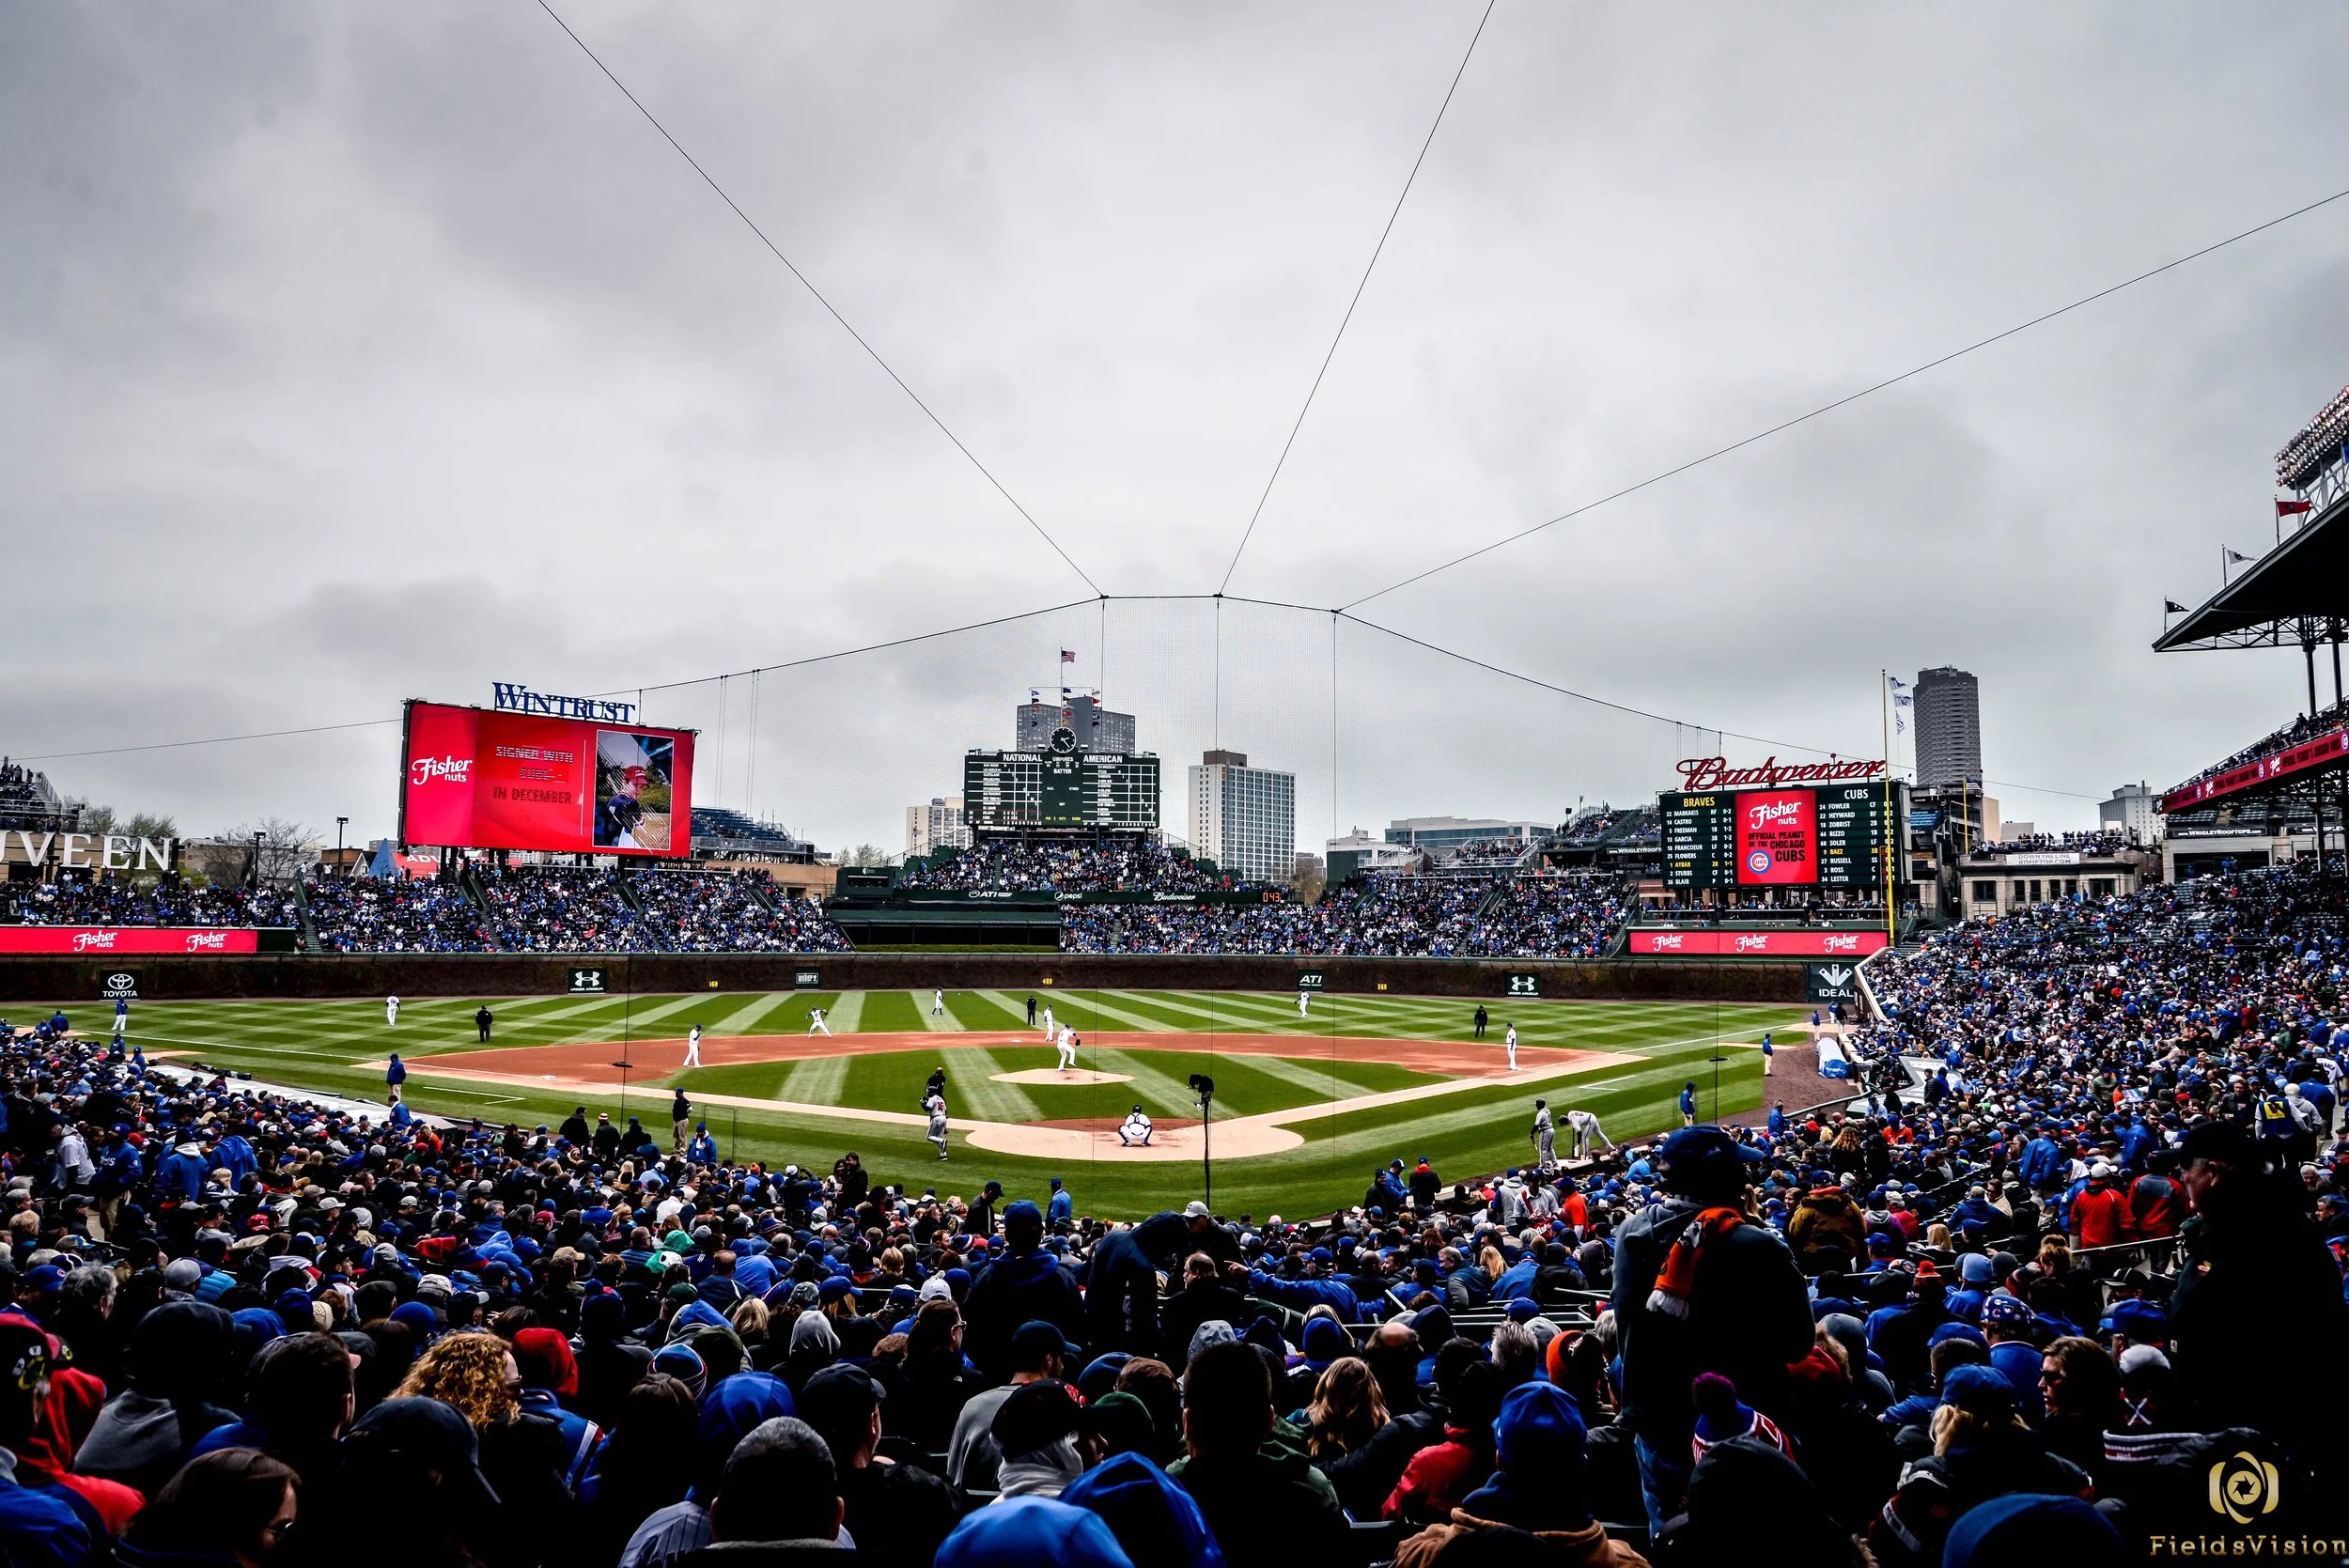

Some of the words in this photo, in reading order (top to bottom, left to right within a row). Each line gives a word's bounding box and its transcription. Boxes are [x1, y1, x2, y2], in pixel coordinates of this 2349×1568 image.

[491, 682, 635, 722] WINTRUST
[412, 755, 473, 785] Fisher
[444, 772, 467, 782] nuts
[1676, 753, 1886, 791] Budweiser
[493, 787, 507, 800] IN
[512, 788, 571, 804] DECEMBER
[1683, 797, 1715, 807] BRAVES
[1844, 789, 1868, 799] CUBS
[1750, 800, 1801, 829] Fisher
[1770, 840, 1805, 849] CHICAGO
[1775, 850, 1805, 862] CUBS
[1152, 892, 1196, 901] Budweiser
[73, 930, 117, 951] Fisher
[187, 932, 227, 952] Fisher
[1653, 934, 1683, 951] Fisher
[1736, 934, 1768, 952] Fisher
[1824, 934, 1858, 952] Fisher
[1819, 988, 1853, 997] IDEAL
